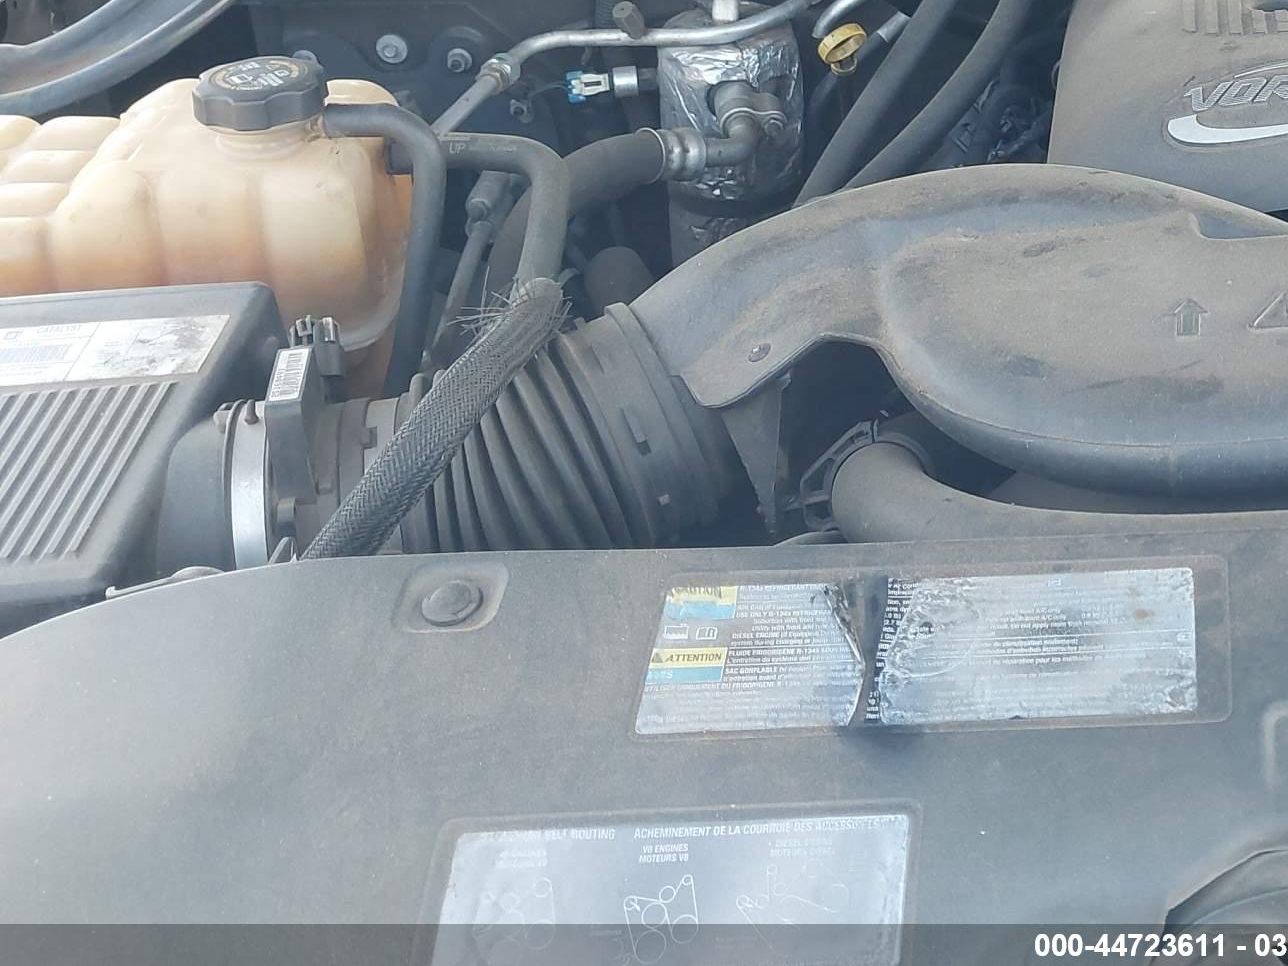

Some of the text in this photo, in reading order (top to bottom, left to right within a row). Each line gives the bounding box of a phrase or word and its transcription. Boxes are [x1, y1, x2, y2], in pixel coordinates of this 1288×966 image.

[666, 652, 722, 663] ATTENTION
[571, 828, 616, 840] ROUTING
[634, 826, 712, 839] ACHEMINEMENT
[713, 826, 726, 836] DE
[728, 825, 742, 835] LA
[654, 843, 688, 853] ENGINES
[638, 853, 677, 864] MOTEURS
